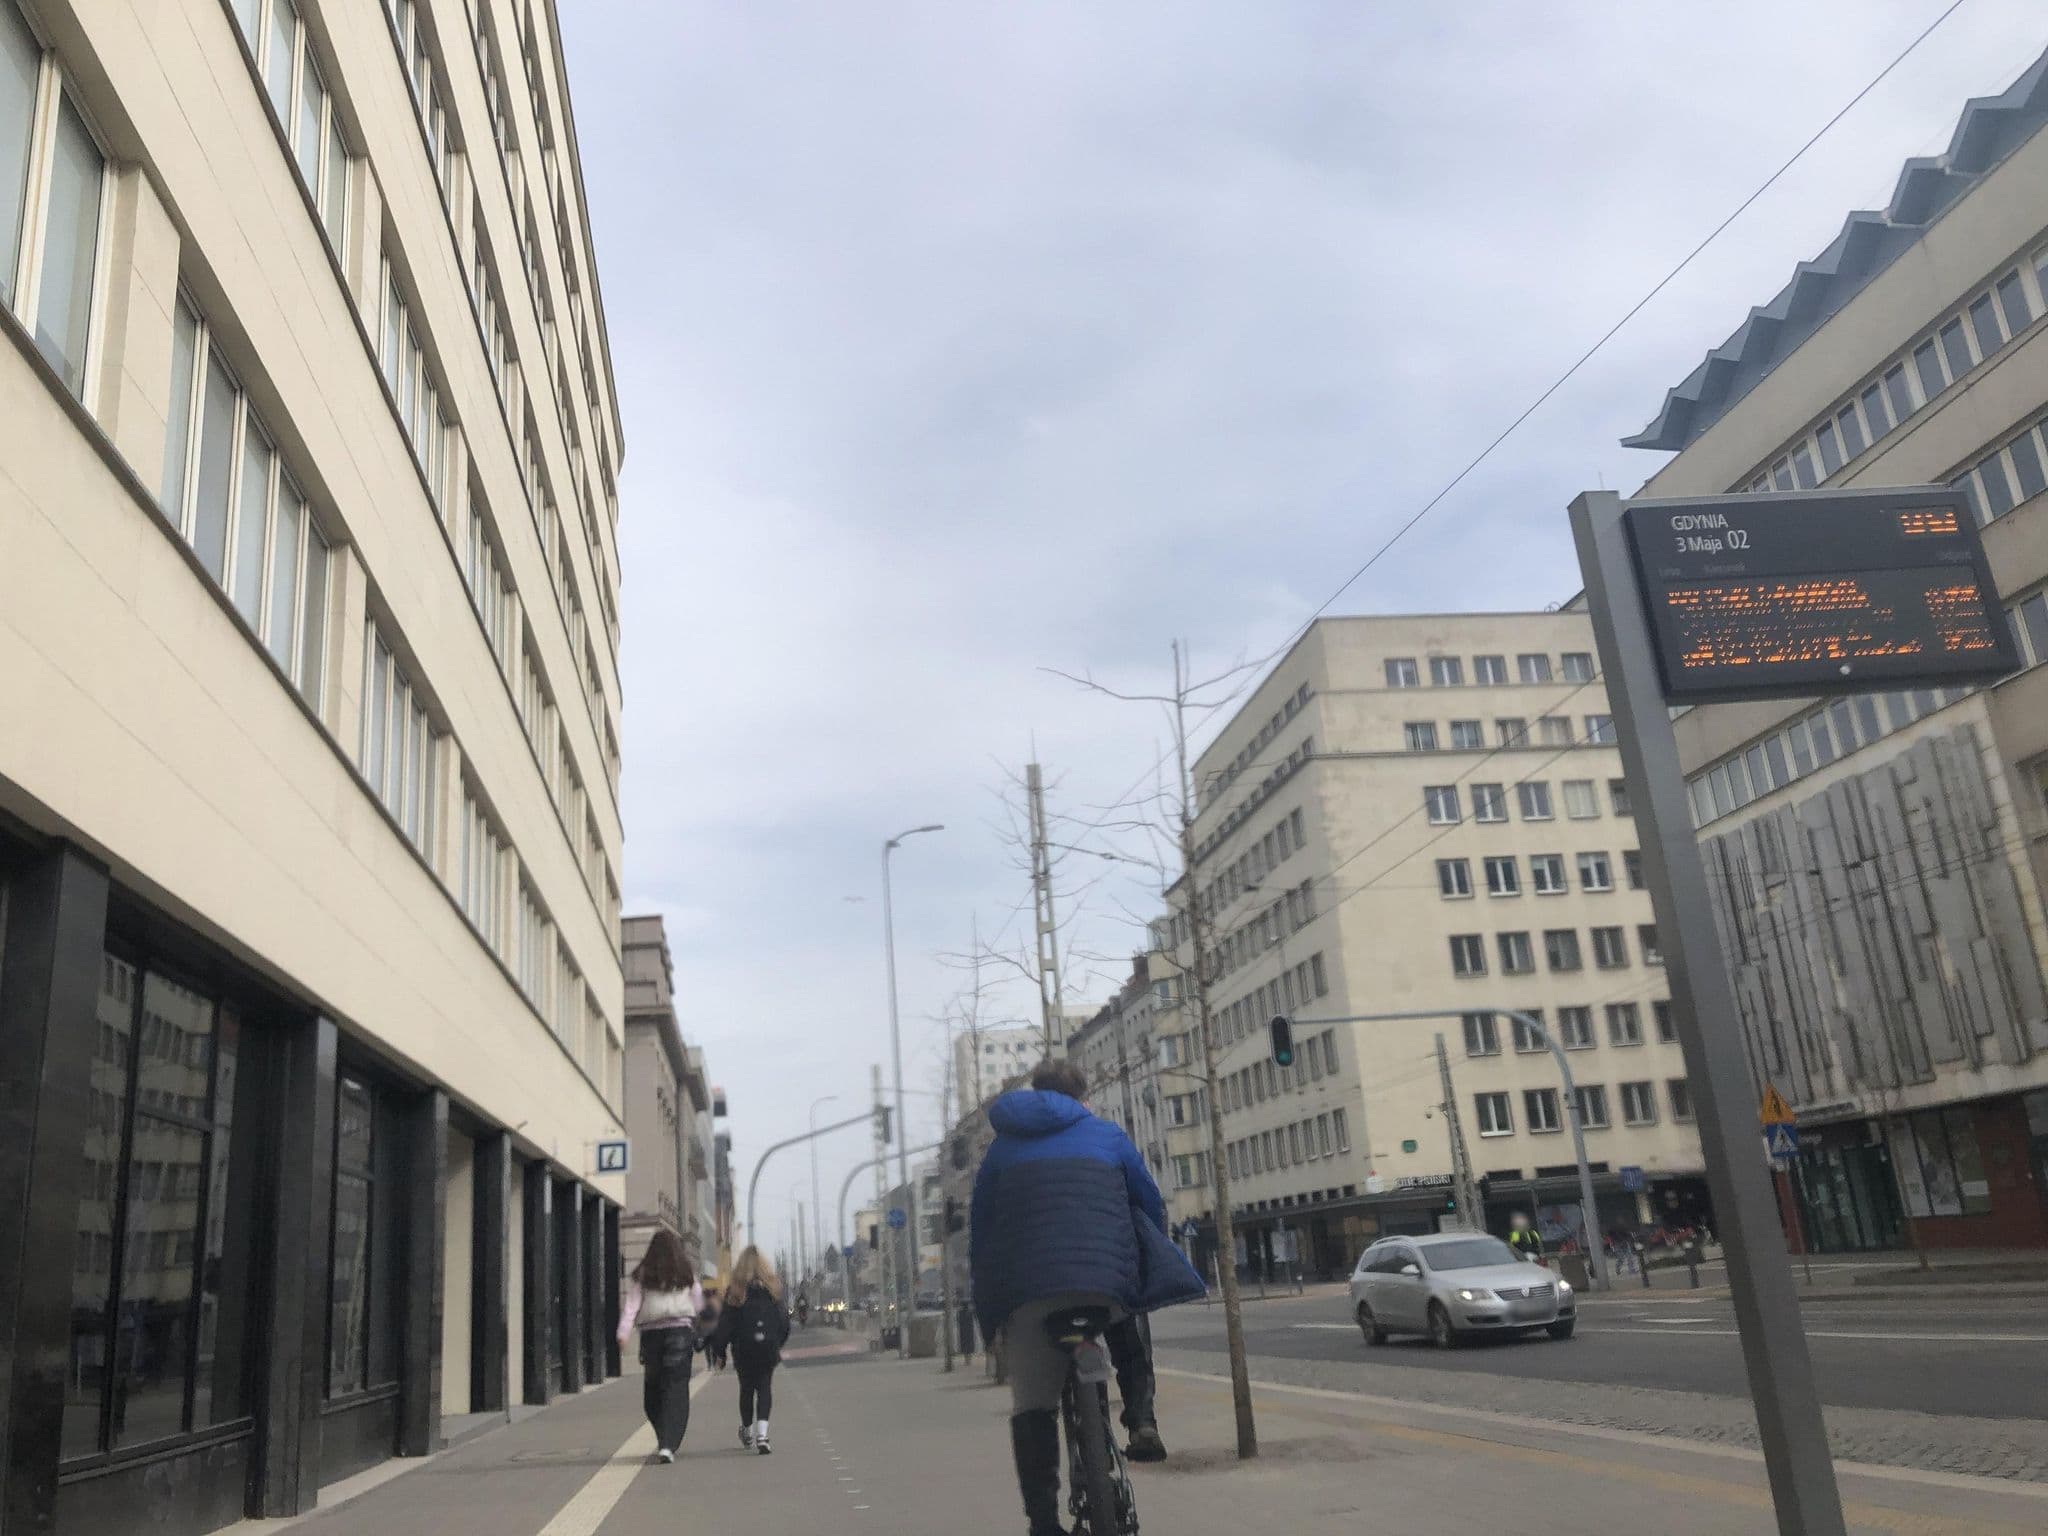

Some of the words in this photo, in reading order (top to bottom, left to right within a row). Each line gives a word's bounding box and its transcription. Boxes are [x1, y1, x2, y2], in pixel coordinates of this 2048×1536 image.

[1671, 514, 1729, 531] GDYNIA
[1675, 537, 1687, 553] 3
[1688, 535, 1723, 555] Maja
[1727, 530, 1751, 550] 02
